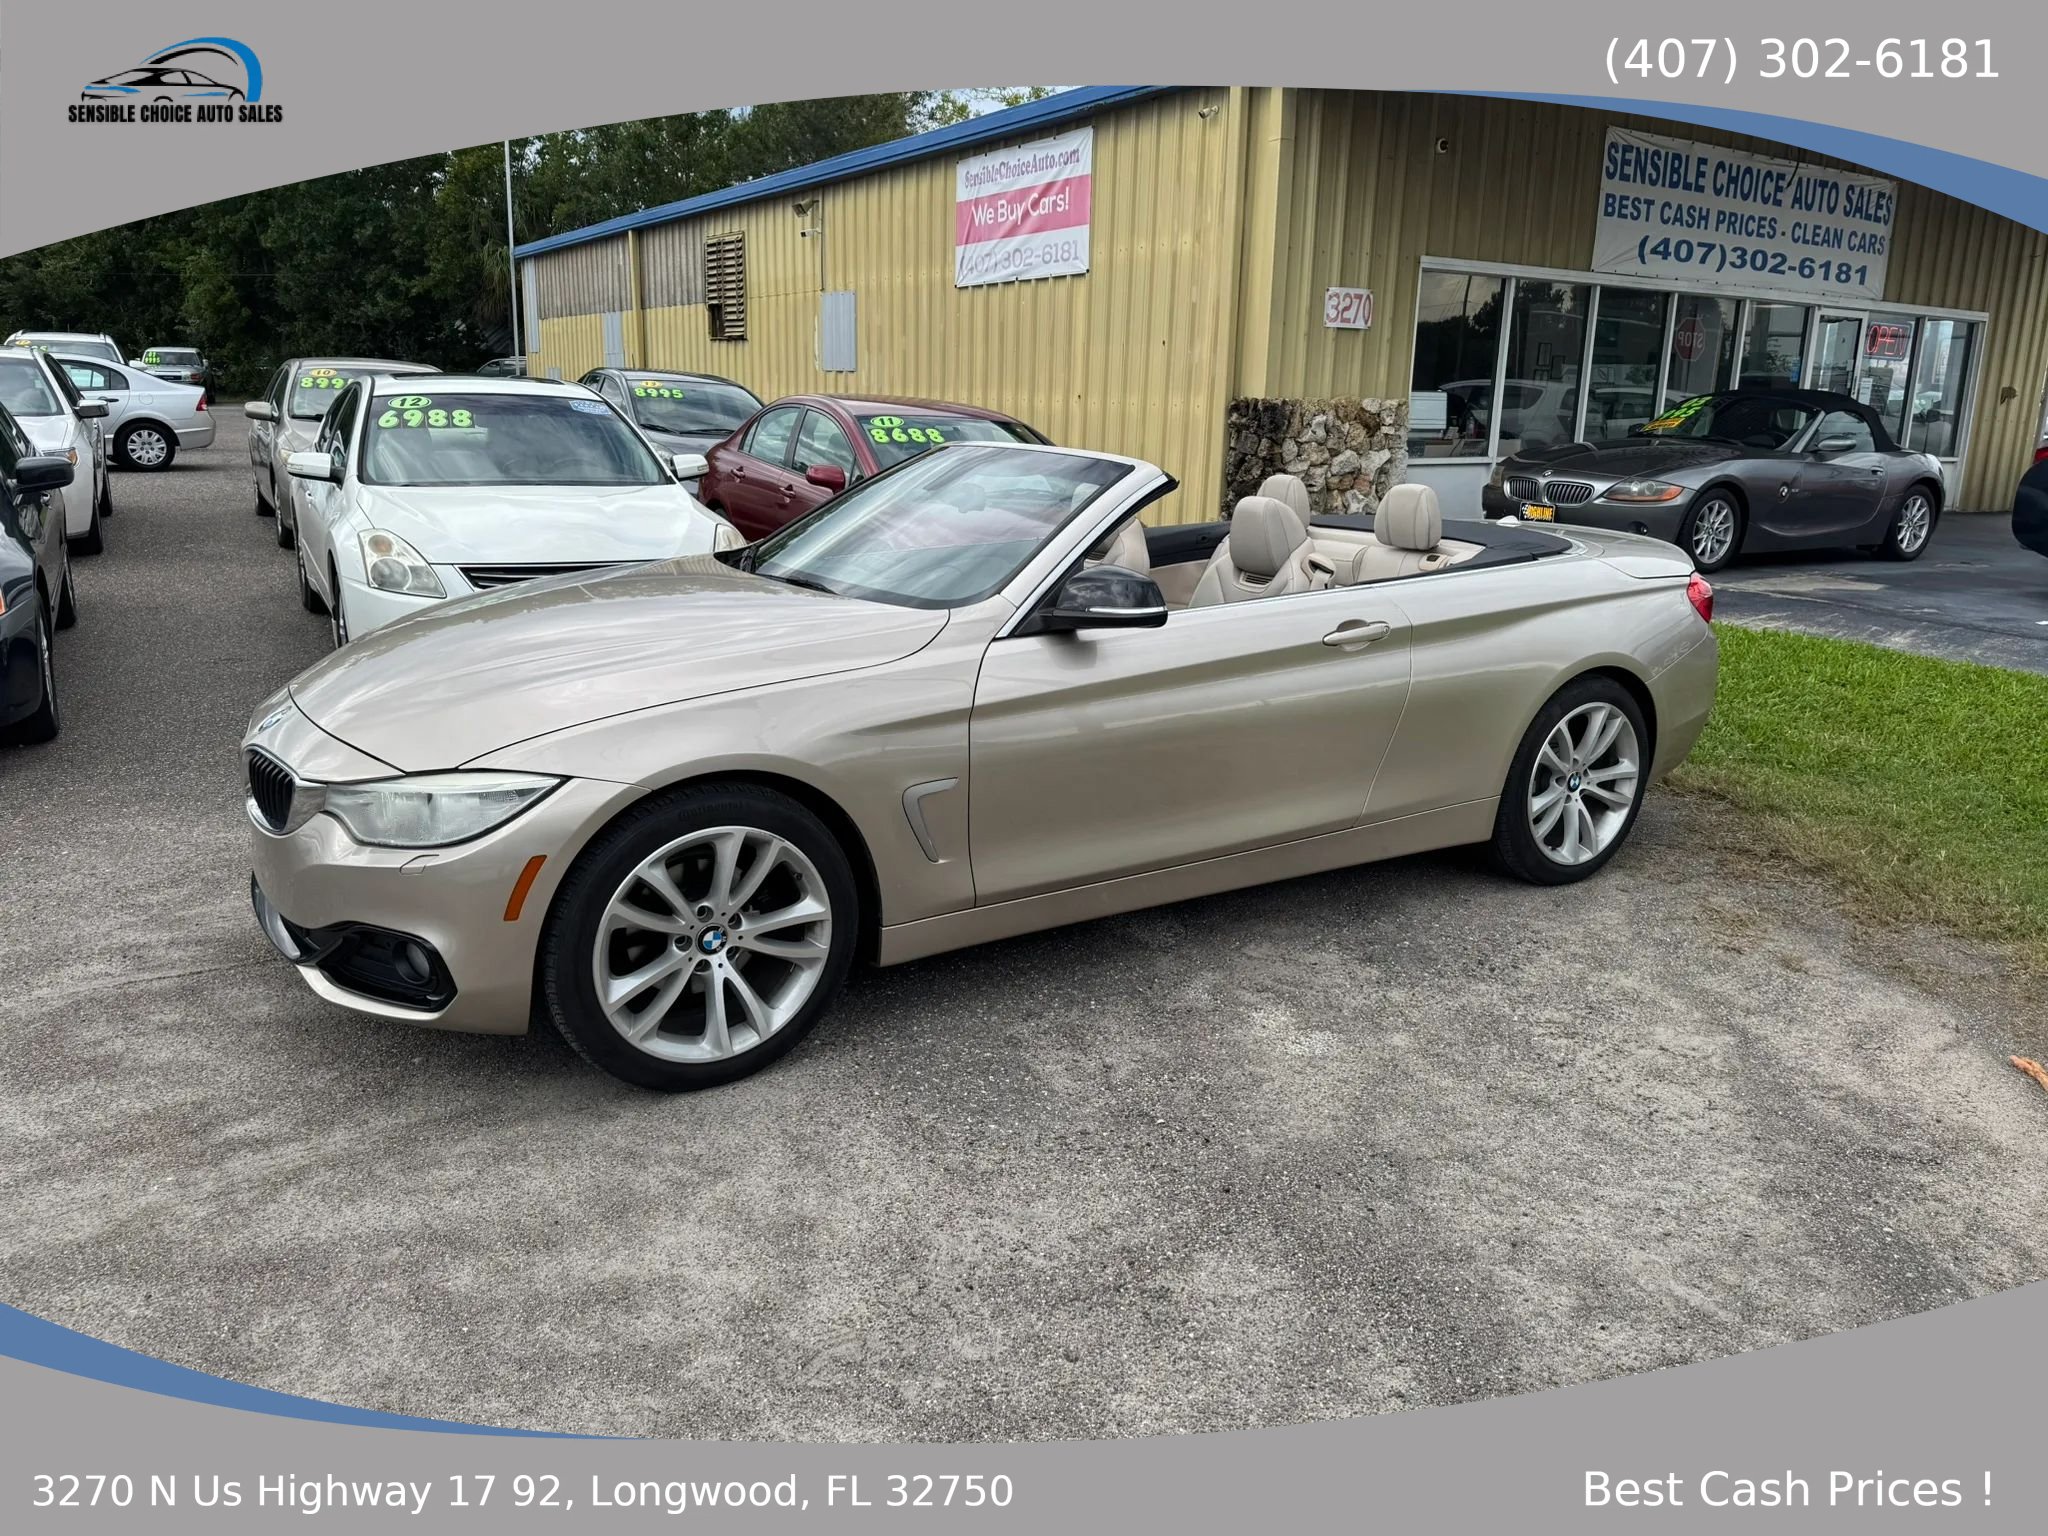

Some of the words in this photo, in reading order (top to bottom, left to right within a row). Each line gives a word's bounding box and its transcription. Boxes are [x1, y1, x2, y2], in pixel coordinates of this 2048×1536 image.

[964, 148, 1080, 189] SensibleChoiceAuto.com
[1605, 141, 1708, 194] SENSIBLE
[1712, 160, 1786, 207] CHOICE
[1791, 176, 1840, 215] AUTO
[1843, 184, 1893, 227] SALES
[972, 203, 994, 227] We
[998, 199, 1026, 225] Buy
[1028, 186, 1070, 217] Cars!
[1603, 192, 1655, 222] BEST
[1660, 201, 1710, 231] CASH
[1715, 210, 1778, 240] PRICES
[1791, 221, 1845, 250] CLEAN
[1848, 230, 1886, 257] CARS
[1637, 235, 1868, 286] (407)302-6181
[1326, 292, 1372, 326] 3270
[301, 377, 352, 389] 899
[635, 387, 684, 399] 8995
[399, 397, 422, 407] 12
[378, 409, 474, 428] 6988
[880, 417, 894, 426] 11
[870, 427, 945, 443] 8688
